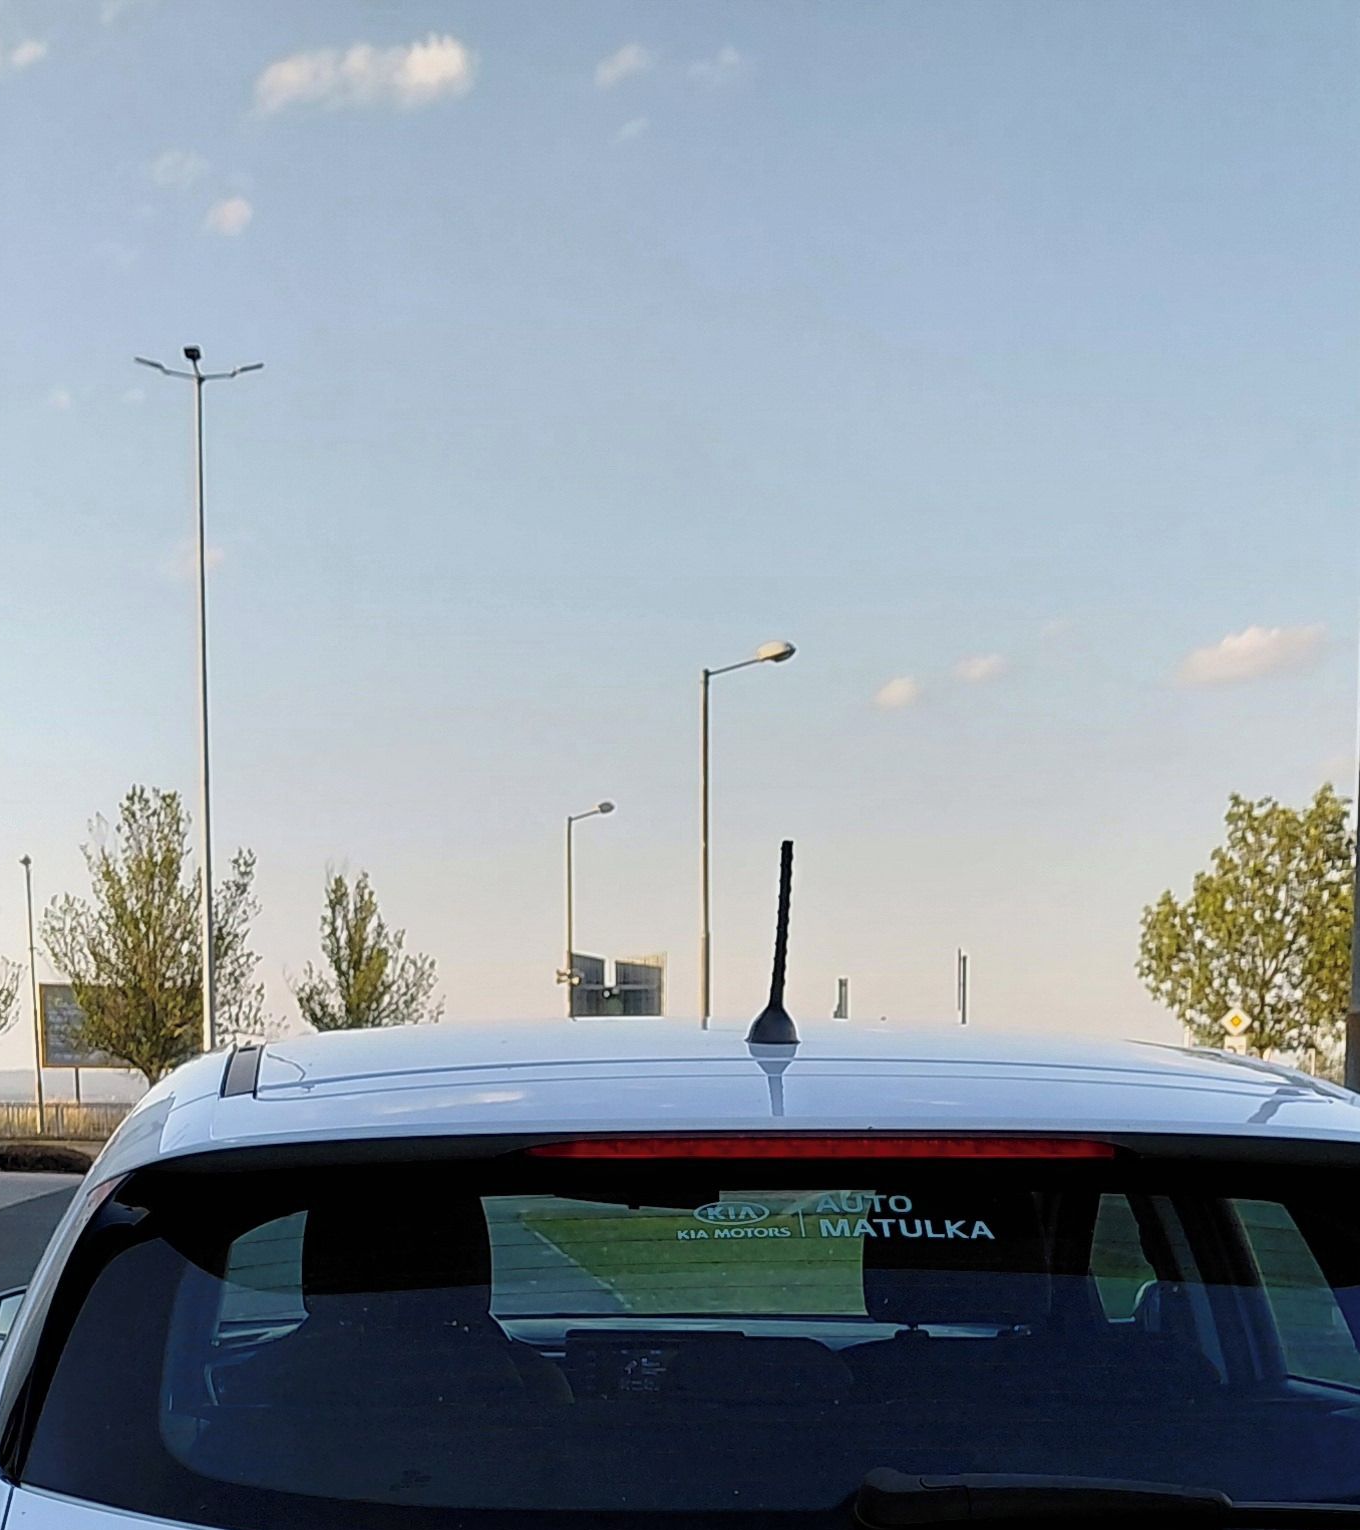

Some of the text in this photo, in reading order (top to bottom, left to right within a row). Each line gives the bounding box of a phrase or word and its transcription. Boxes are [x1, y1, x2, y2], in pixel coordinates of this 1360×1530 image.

[815, 1195, 913, 1213] AUTO
[706, 1206, 758, 1221] KIA
[677, 1226, 791, 1240] KIA MOTORS
[819, 1218, 996, 1240] MATULKA
